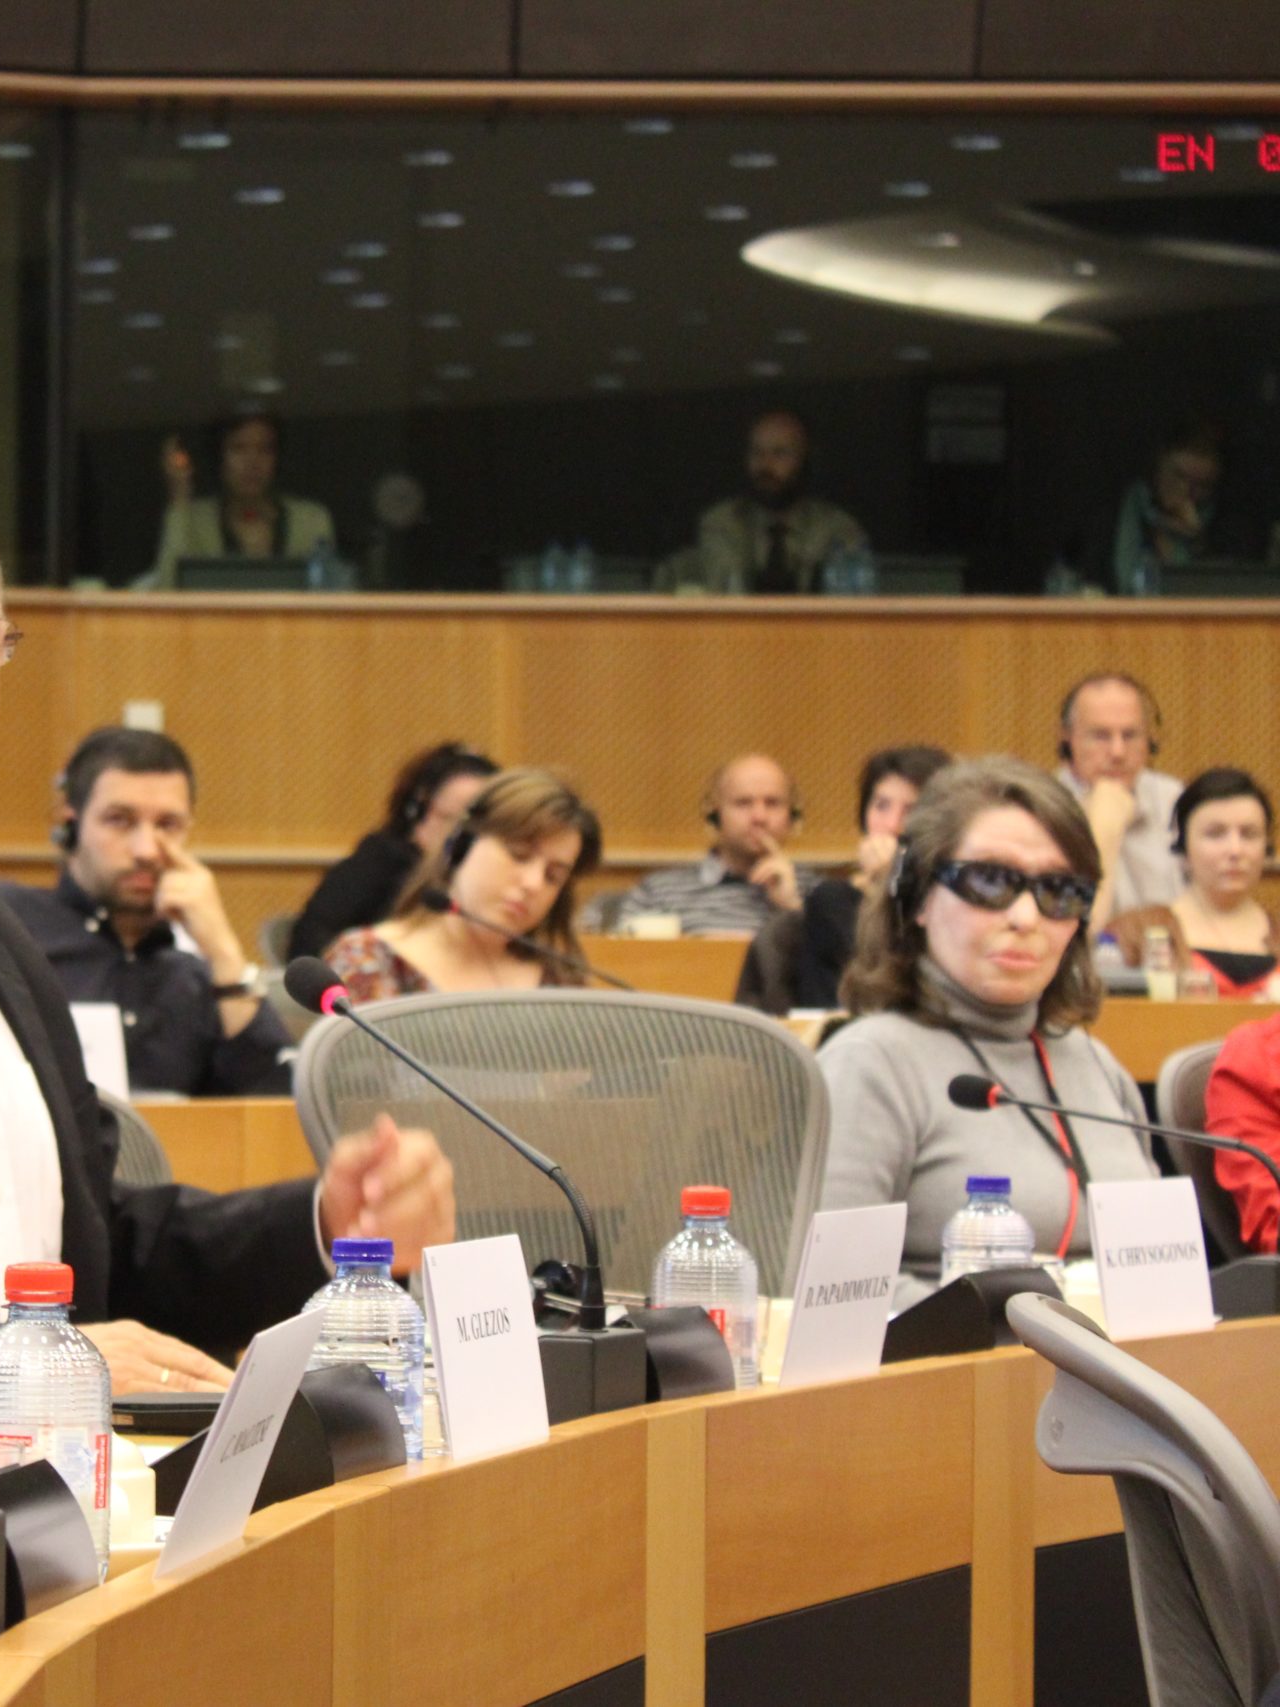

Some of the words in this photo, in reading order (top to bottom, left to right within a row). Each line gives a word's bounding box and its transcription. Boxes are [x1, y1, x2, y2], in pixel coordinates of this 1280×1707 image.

[1157, 132, 1215, 172] EN
[1118, 1242, 1200, 1267] CHRYSOGONOS
[456, 1314, 470, 1343] M.
[470, 1307, 511, 1341] GLEZOS
